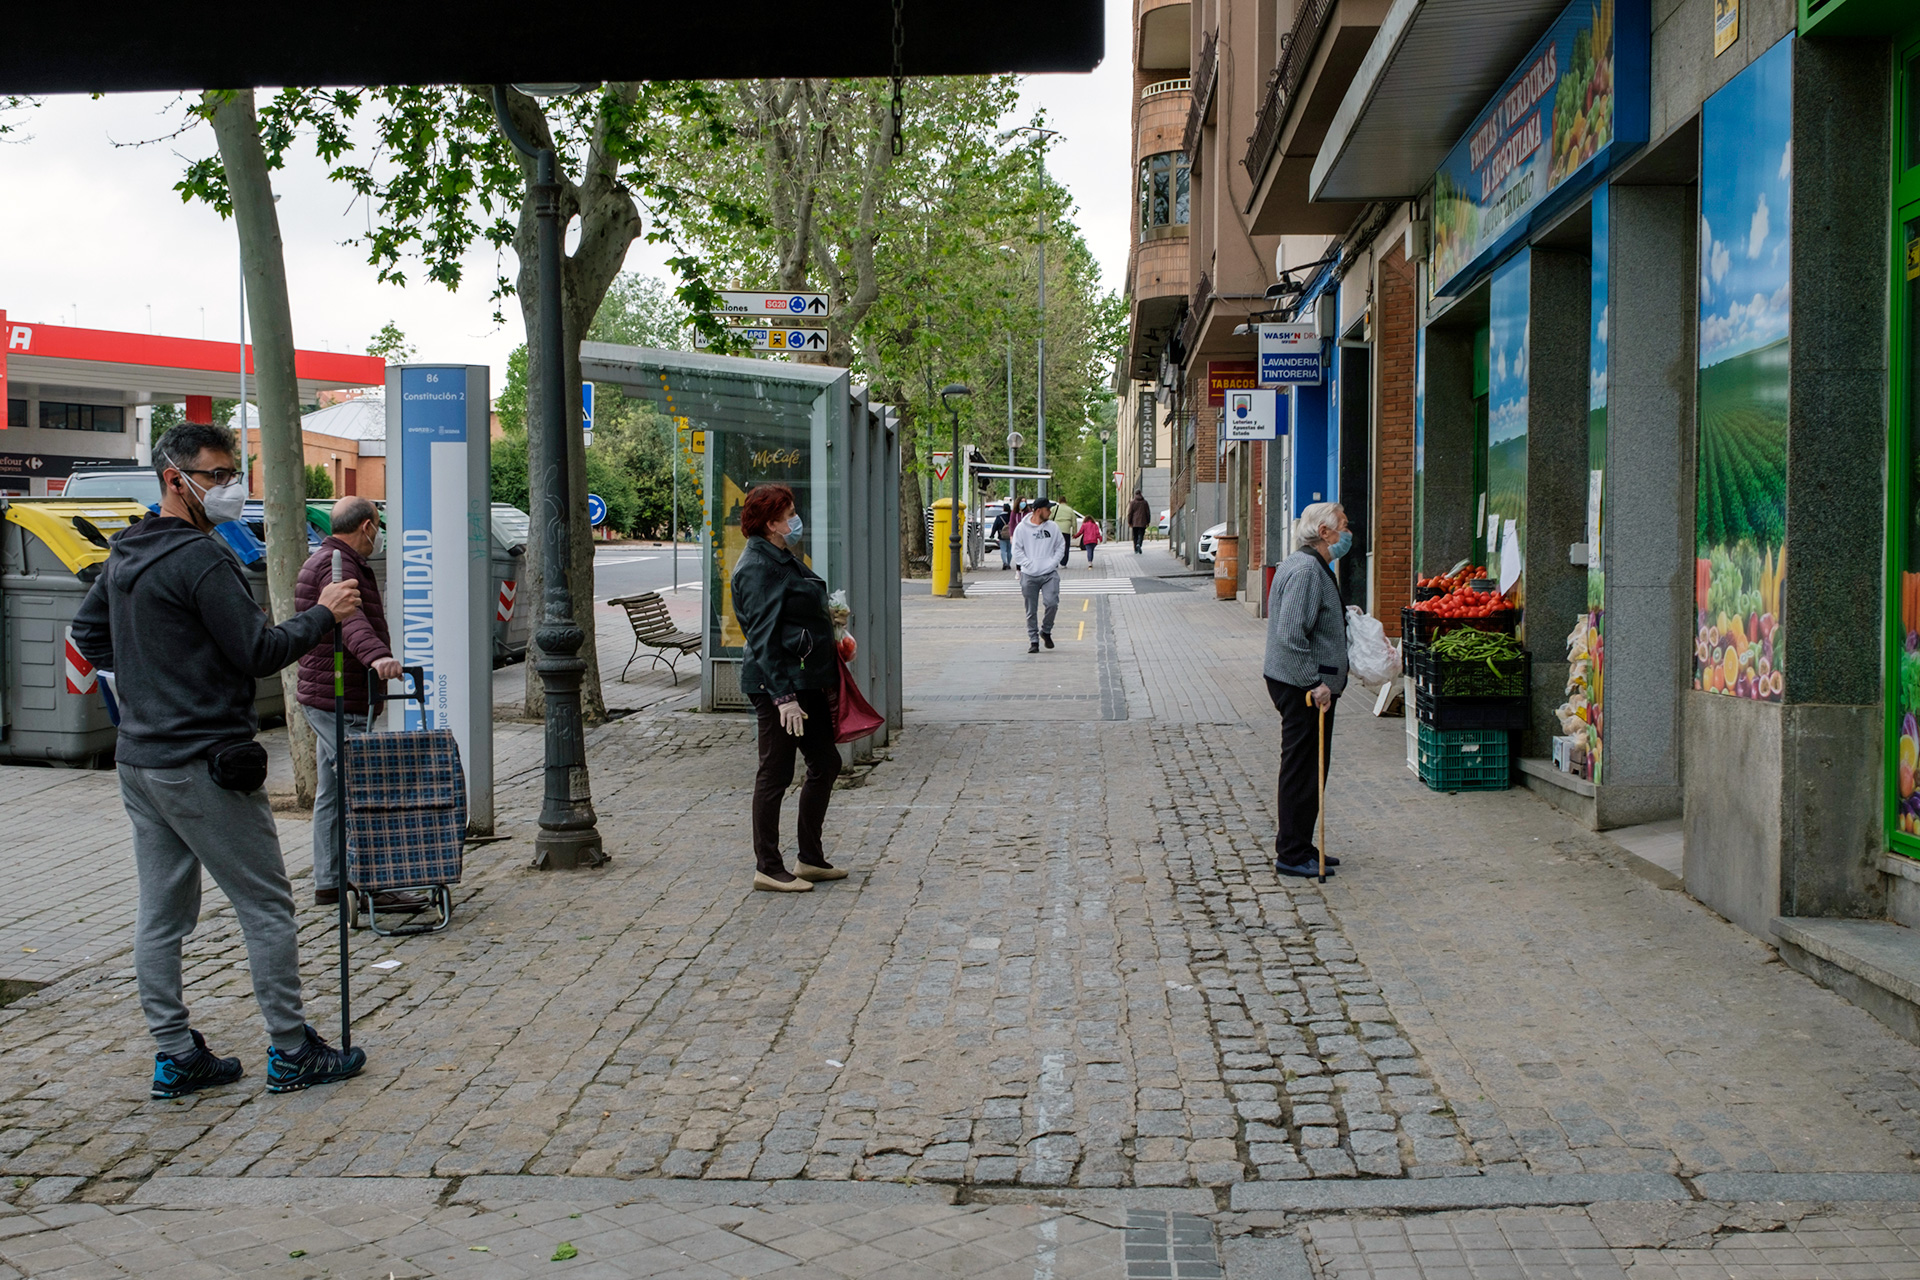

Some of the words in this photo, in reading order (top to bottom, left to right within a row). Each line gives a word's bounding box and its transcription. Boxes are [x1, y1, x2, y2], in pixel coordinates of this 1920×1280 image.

[1469, 108, 1497, 173] FRUTAS
[1498, 100, 1505, 138] Y
[1504, 42, 1556, 129] VERDURAS
[1481, 165, 1491, 203] LA
[1491, 109, 1542, 192] SEGOVIANA
[1482, 170, 1535, 239] AUTOSERVICIO
[766, 300, 786, 308] SG20
[748, 331, 766, 339] AP61
[1262, 358, 1319, 367] LAVANDERIA
[426, 373, 439, 383] 86
[1263, 369, 1318, 379] TINTORERIA
[1211, 379, 1255, 389] TABACOS
[403, 392, 457, 400] Constitución
[459, 392, 465, 400] 2
[1143, 394, 1152, 465] RESTAURANTE
[752, 448, 800, 469] McCafé
[403, 529, 433, 672] MOVILIDAD
[438, 674, 447, 709] somos
